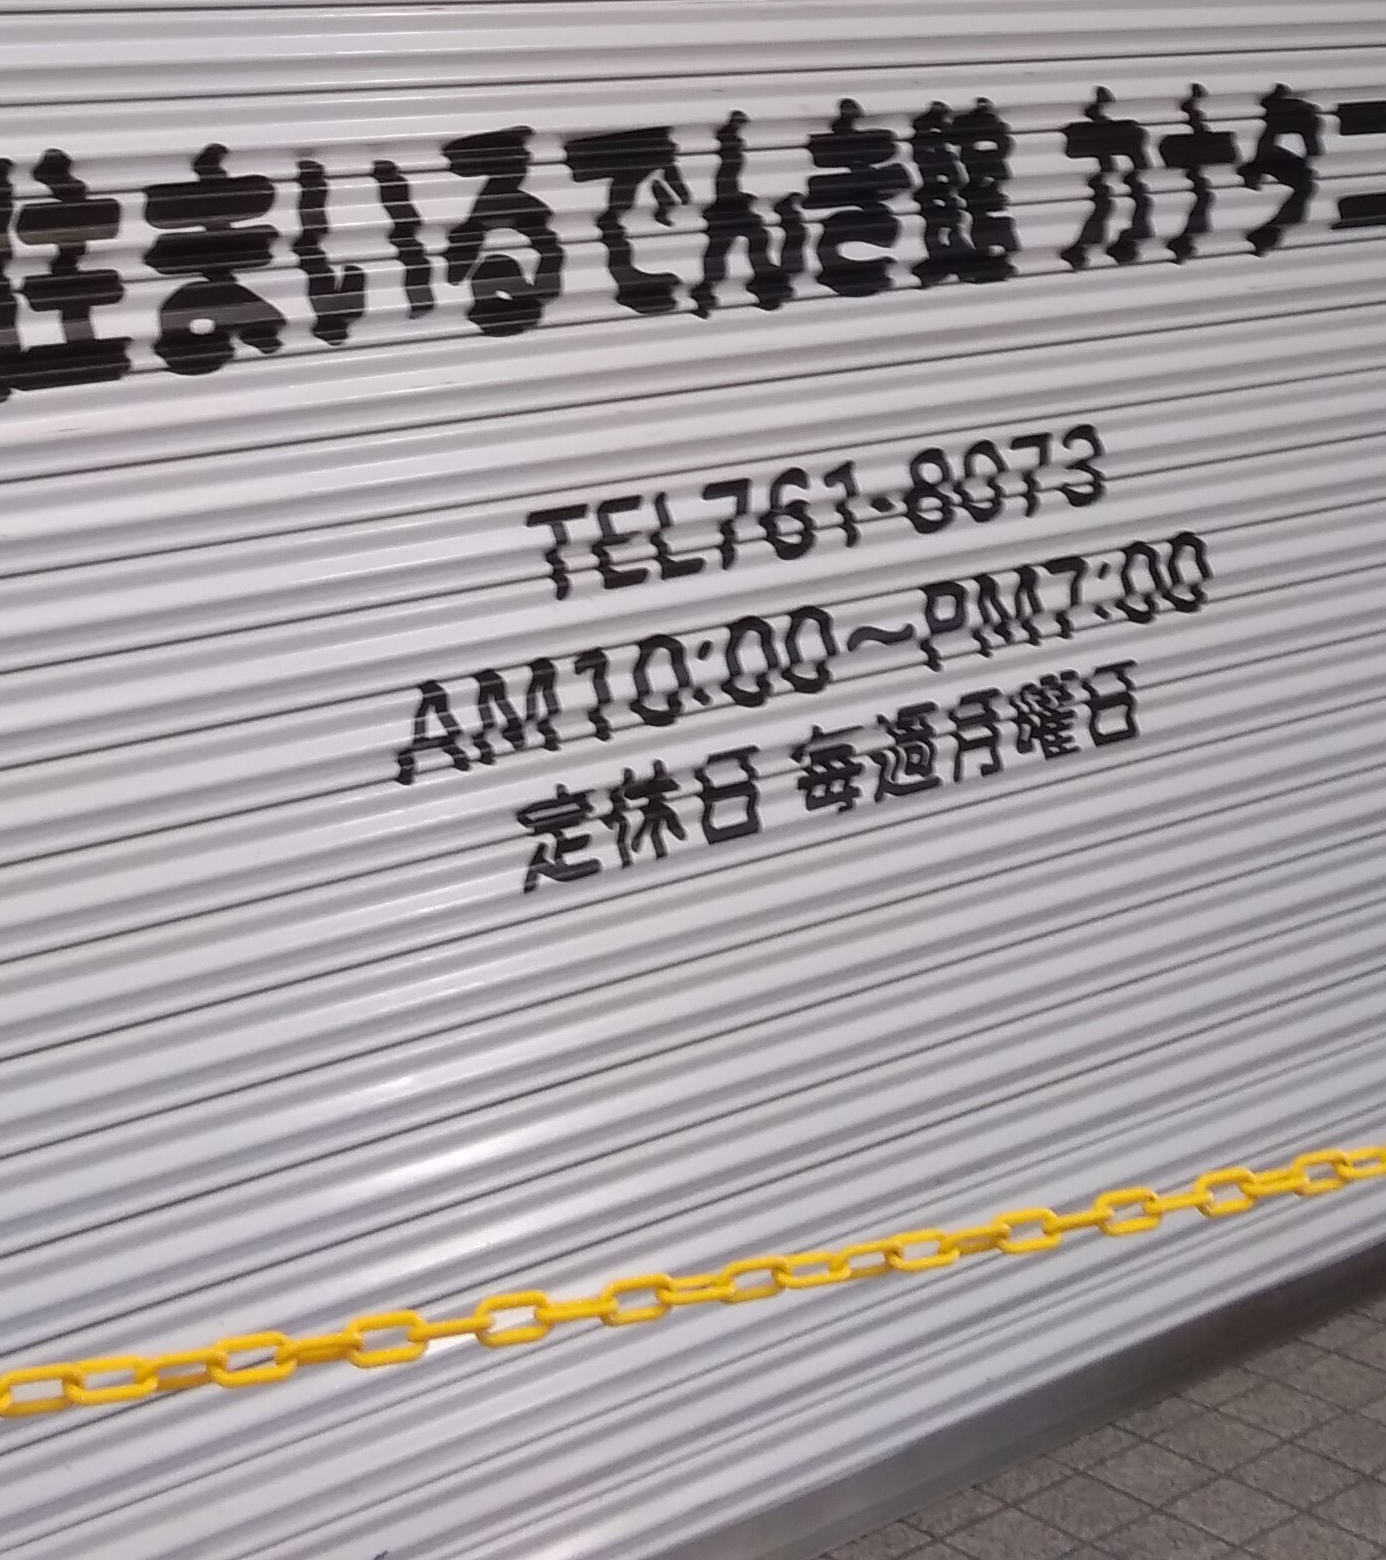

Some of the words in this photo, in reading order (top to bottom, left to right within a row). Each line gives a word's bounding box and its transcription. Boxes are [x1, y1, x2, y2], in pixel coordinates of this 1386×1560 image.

[515, 744, 764, 894] 定休日
[791, 658, 1139, 813] 毎週月曜日
